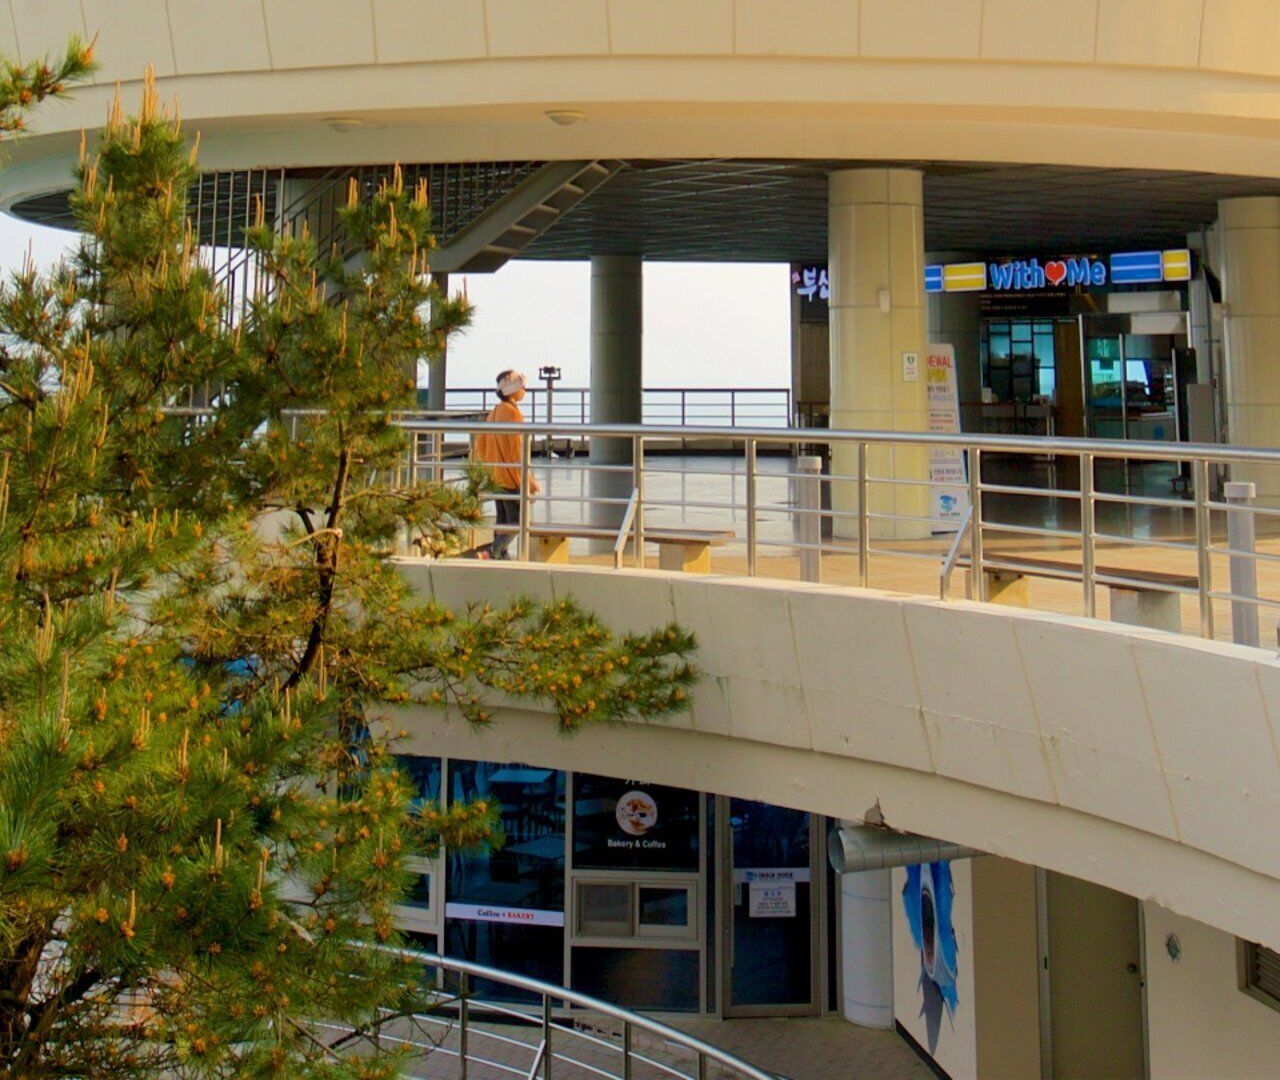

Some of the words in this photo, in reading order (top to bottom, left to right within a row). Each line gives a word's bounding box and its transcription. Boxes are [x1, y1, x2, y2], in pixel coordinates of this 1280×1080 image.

[989, 258, 1045, 290] With
[1067, 258, 1106, 285] Me
[927, 355, 953, 368] NEWAL
[607, 839, 633, 849] Bakery
[642, 840, 666, 849] Coffee
[507, 911, 536, 920] BAKERY
